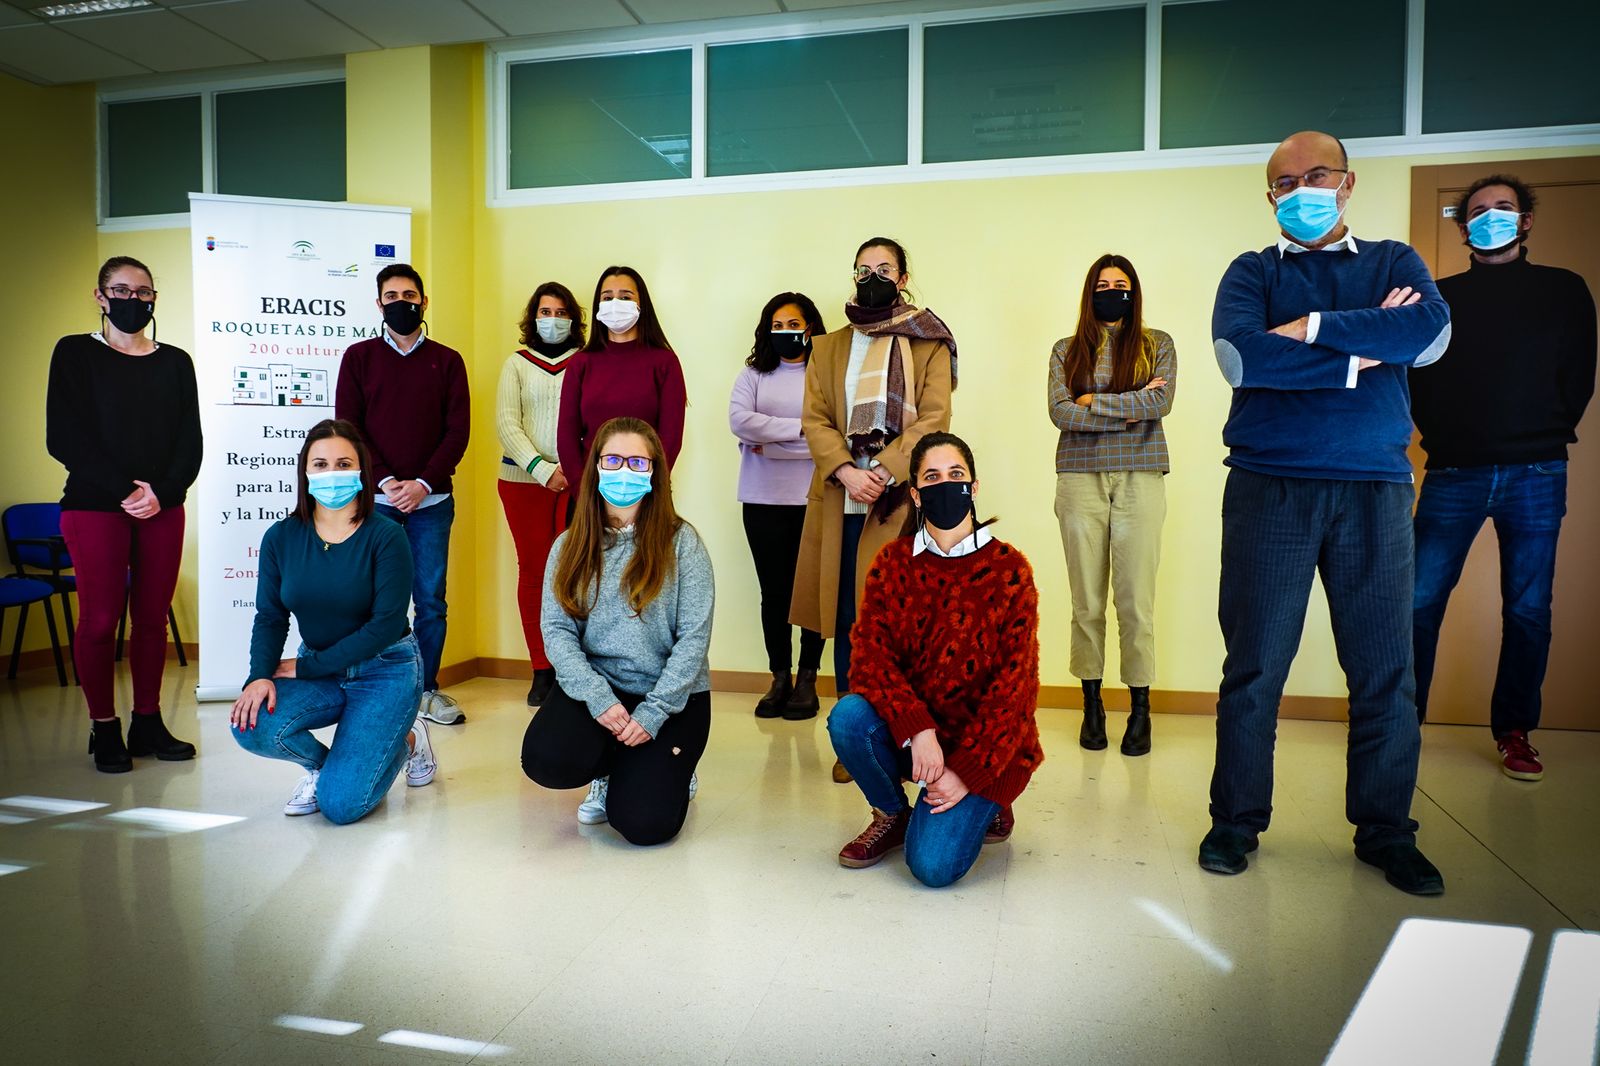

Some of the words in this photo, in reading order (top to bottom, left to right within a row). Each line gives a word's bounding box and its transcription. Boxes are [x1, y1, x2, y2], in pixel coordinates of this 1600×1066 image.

[261, 296, 346, 316] ERACIS
[212, 321, 316, 336] ROQUETAS
[323, 326, 346, 337] DE
[352, 326, 380, 338] MA
[249, 343, 280, 355] 200
[286, 344, 343, 357] cultur
[262, 425, 308, 439] Estra
[235, 483, 273, 497] para
[278, 480, 293, 493] la
[221, 511, 231, 525] y
[237, 507, 252, 520] la
[258, 507, 291, 520] Incl
[233, 599, 255, 608] Plan
